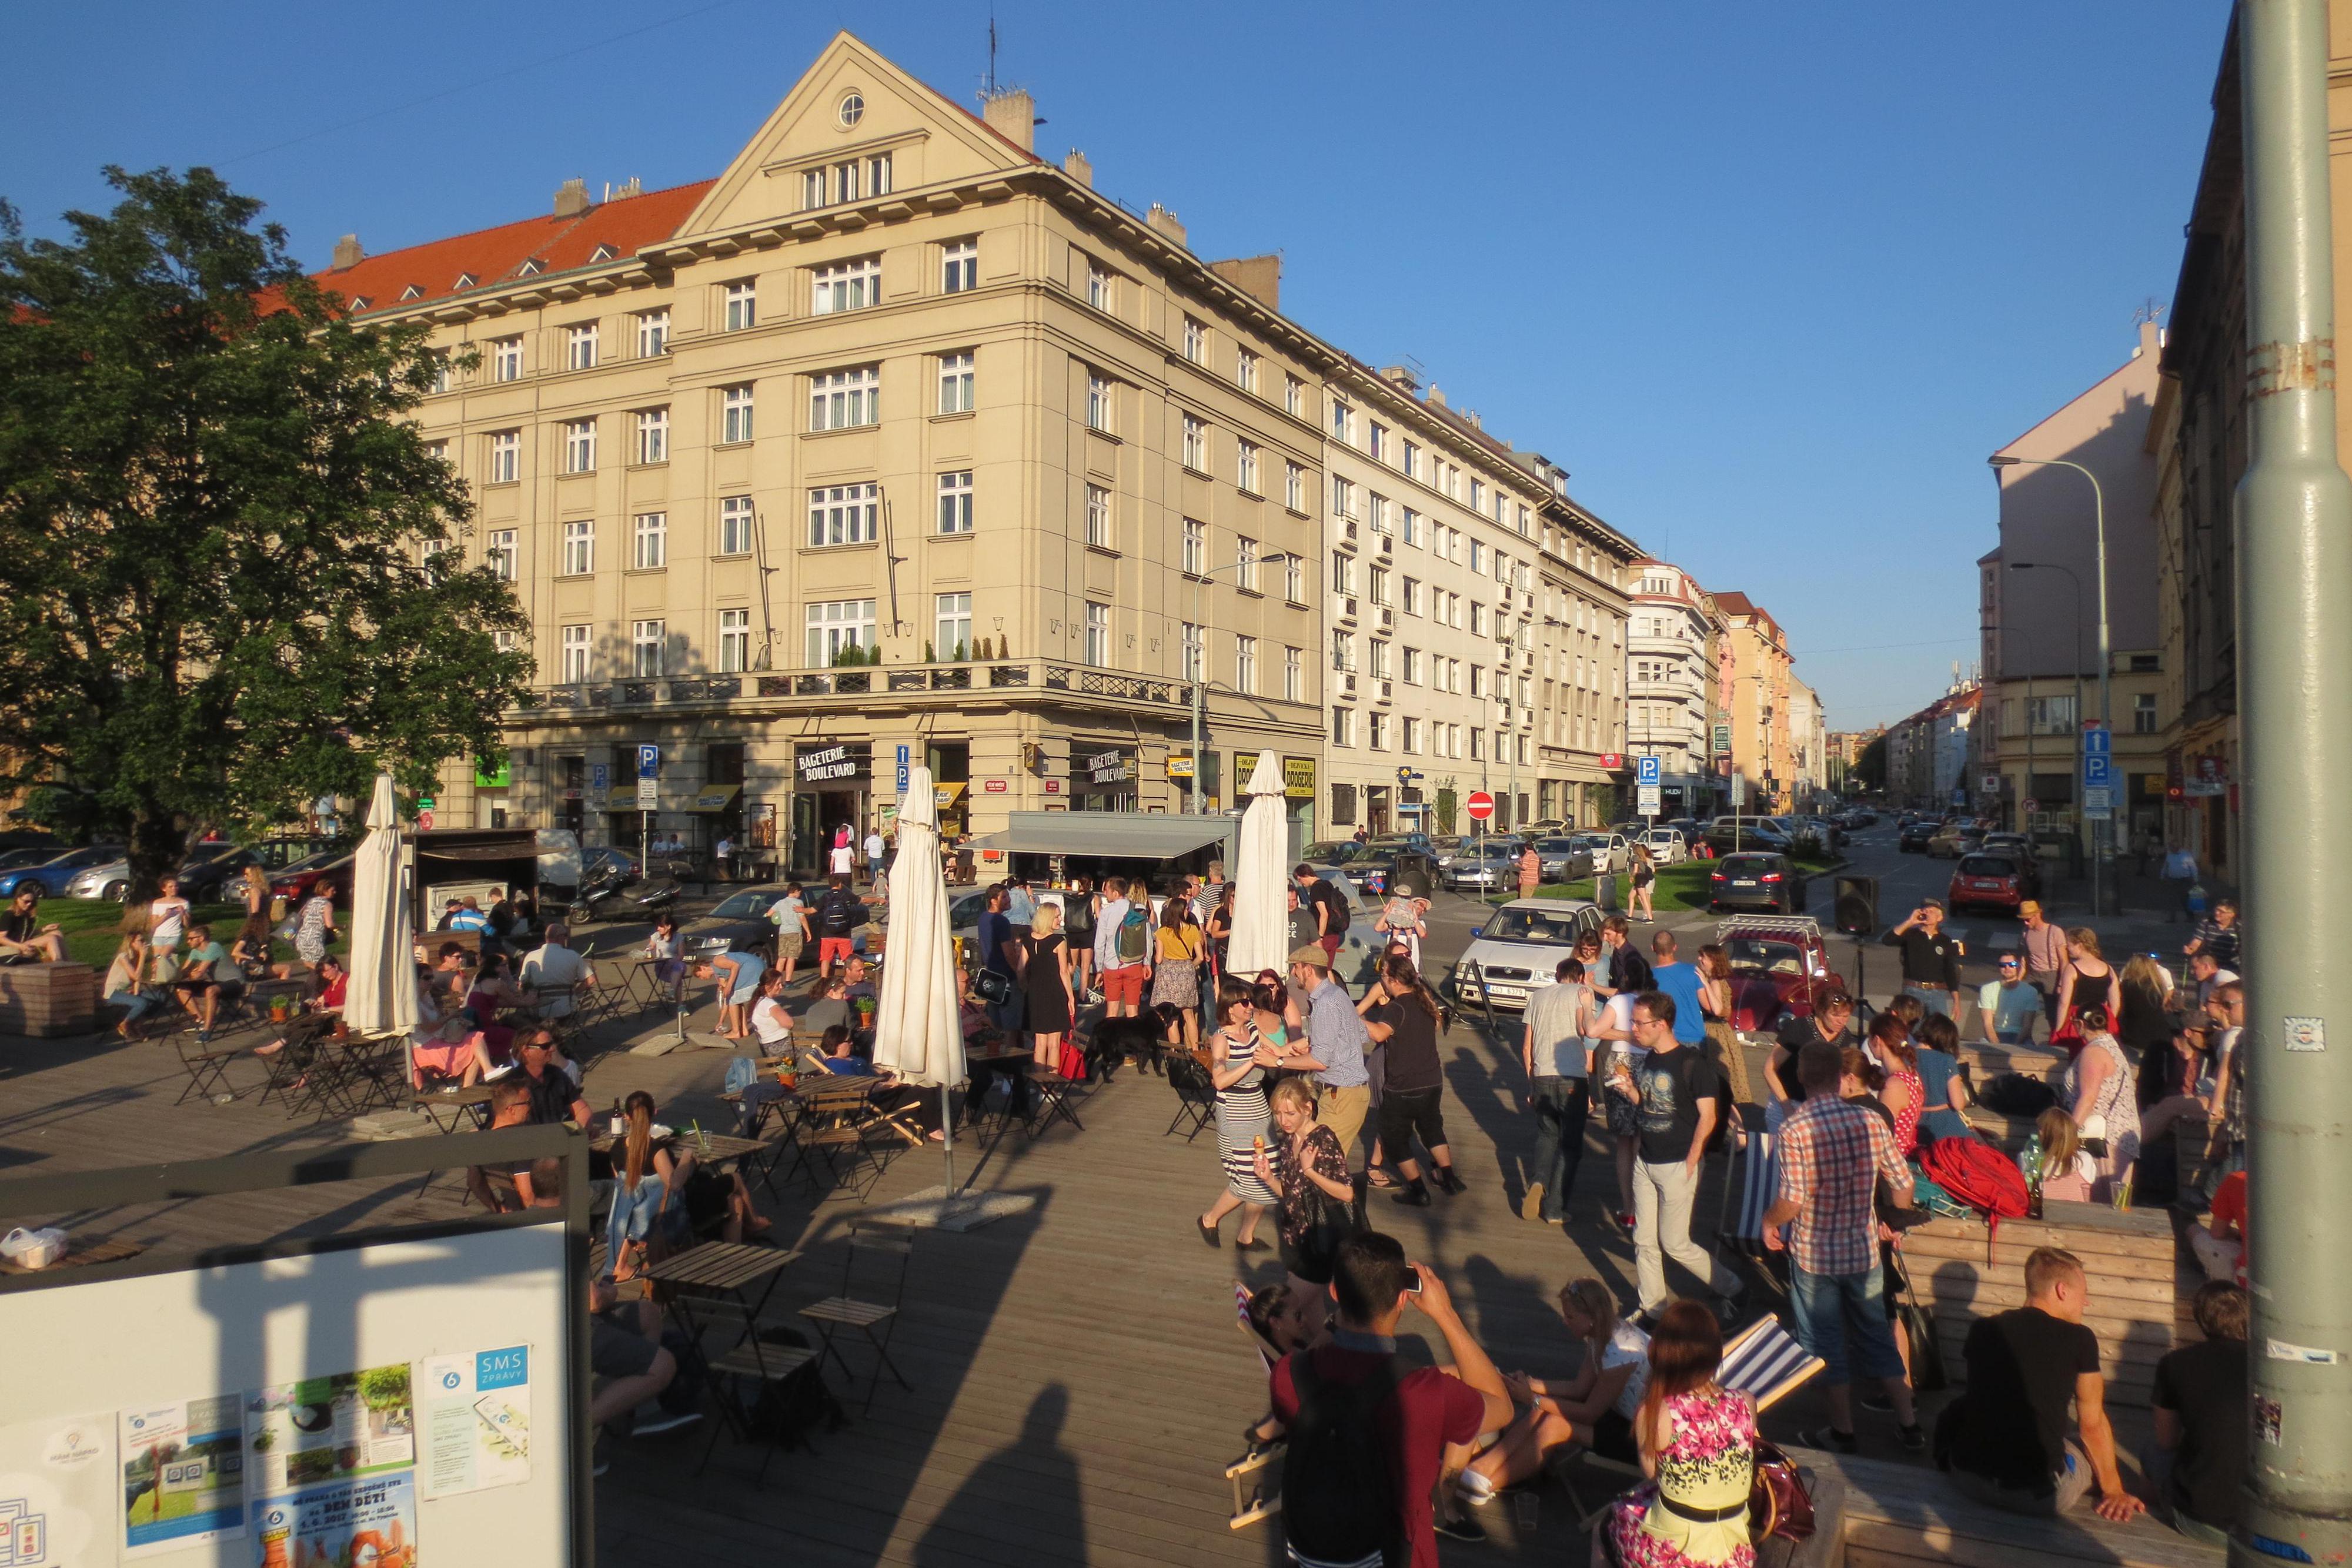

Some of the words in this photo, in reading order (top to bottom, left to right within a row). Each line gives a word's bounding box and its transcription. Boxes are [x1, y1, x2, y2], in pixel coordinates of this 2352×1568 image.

[643, 749, 654, 767] P
[799, 745, 846, 770] BAGETERIE
[1088, 750, 1120, 771] BAGETERIE
[806, 763, 856, 781] BOULEVARD
[898, 768, 907, 783] P
[1094, 767, 1127, 784] BOULEVARD
[1643, 760, 1655, 777] P
[2089, 758, 2104, 777] P
[1287, 771, 1313, 788] DROGERIE
[482, 1353, 522, 1372] SMS
[447, 1373, 457, 1386] 6
